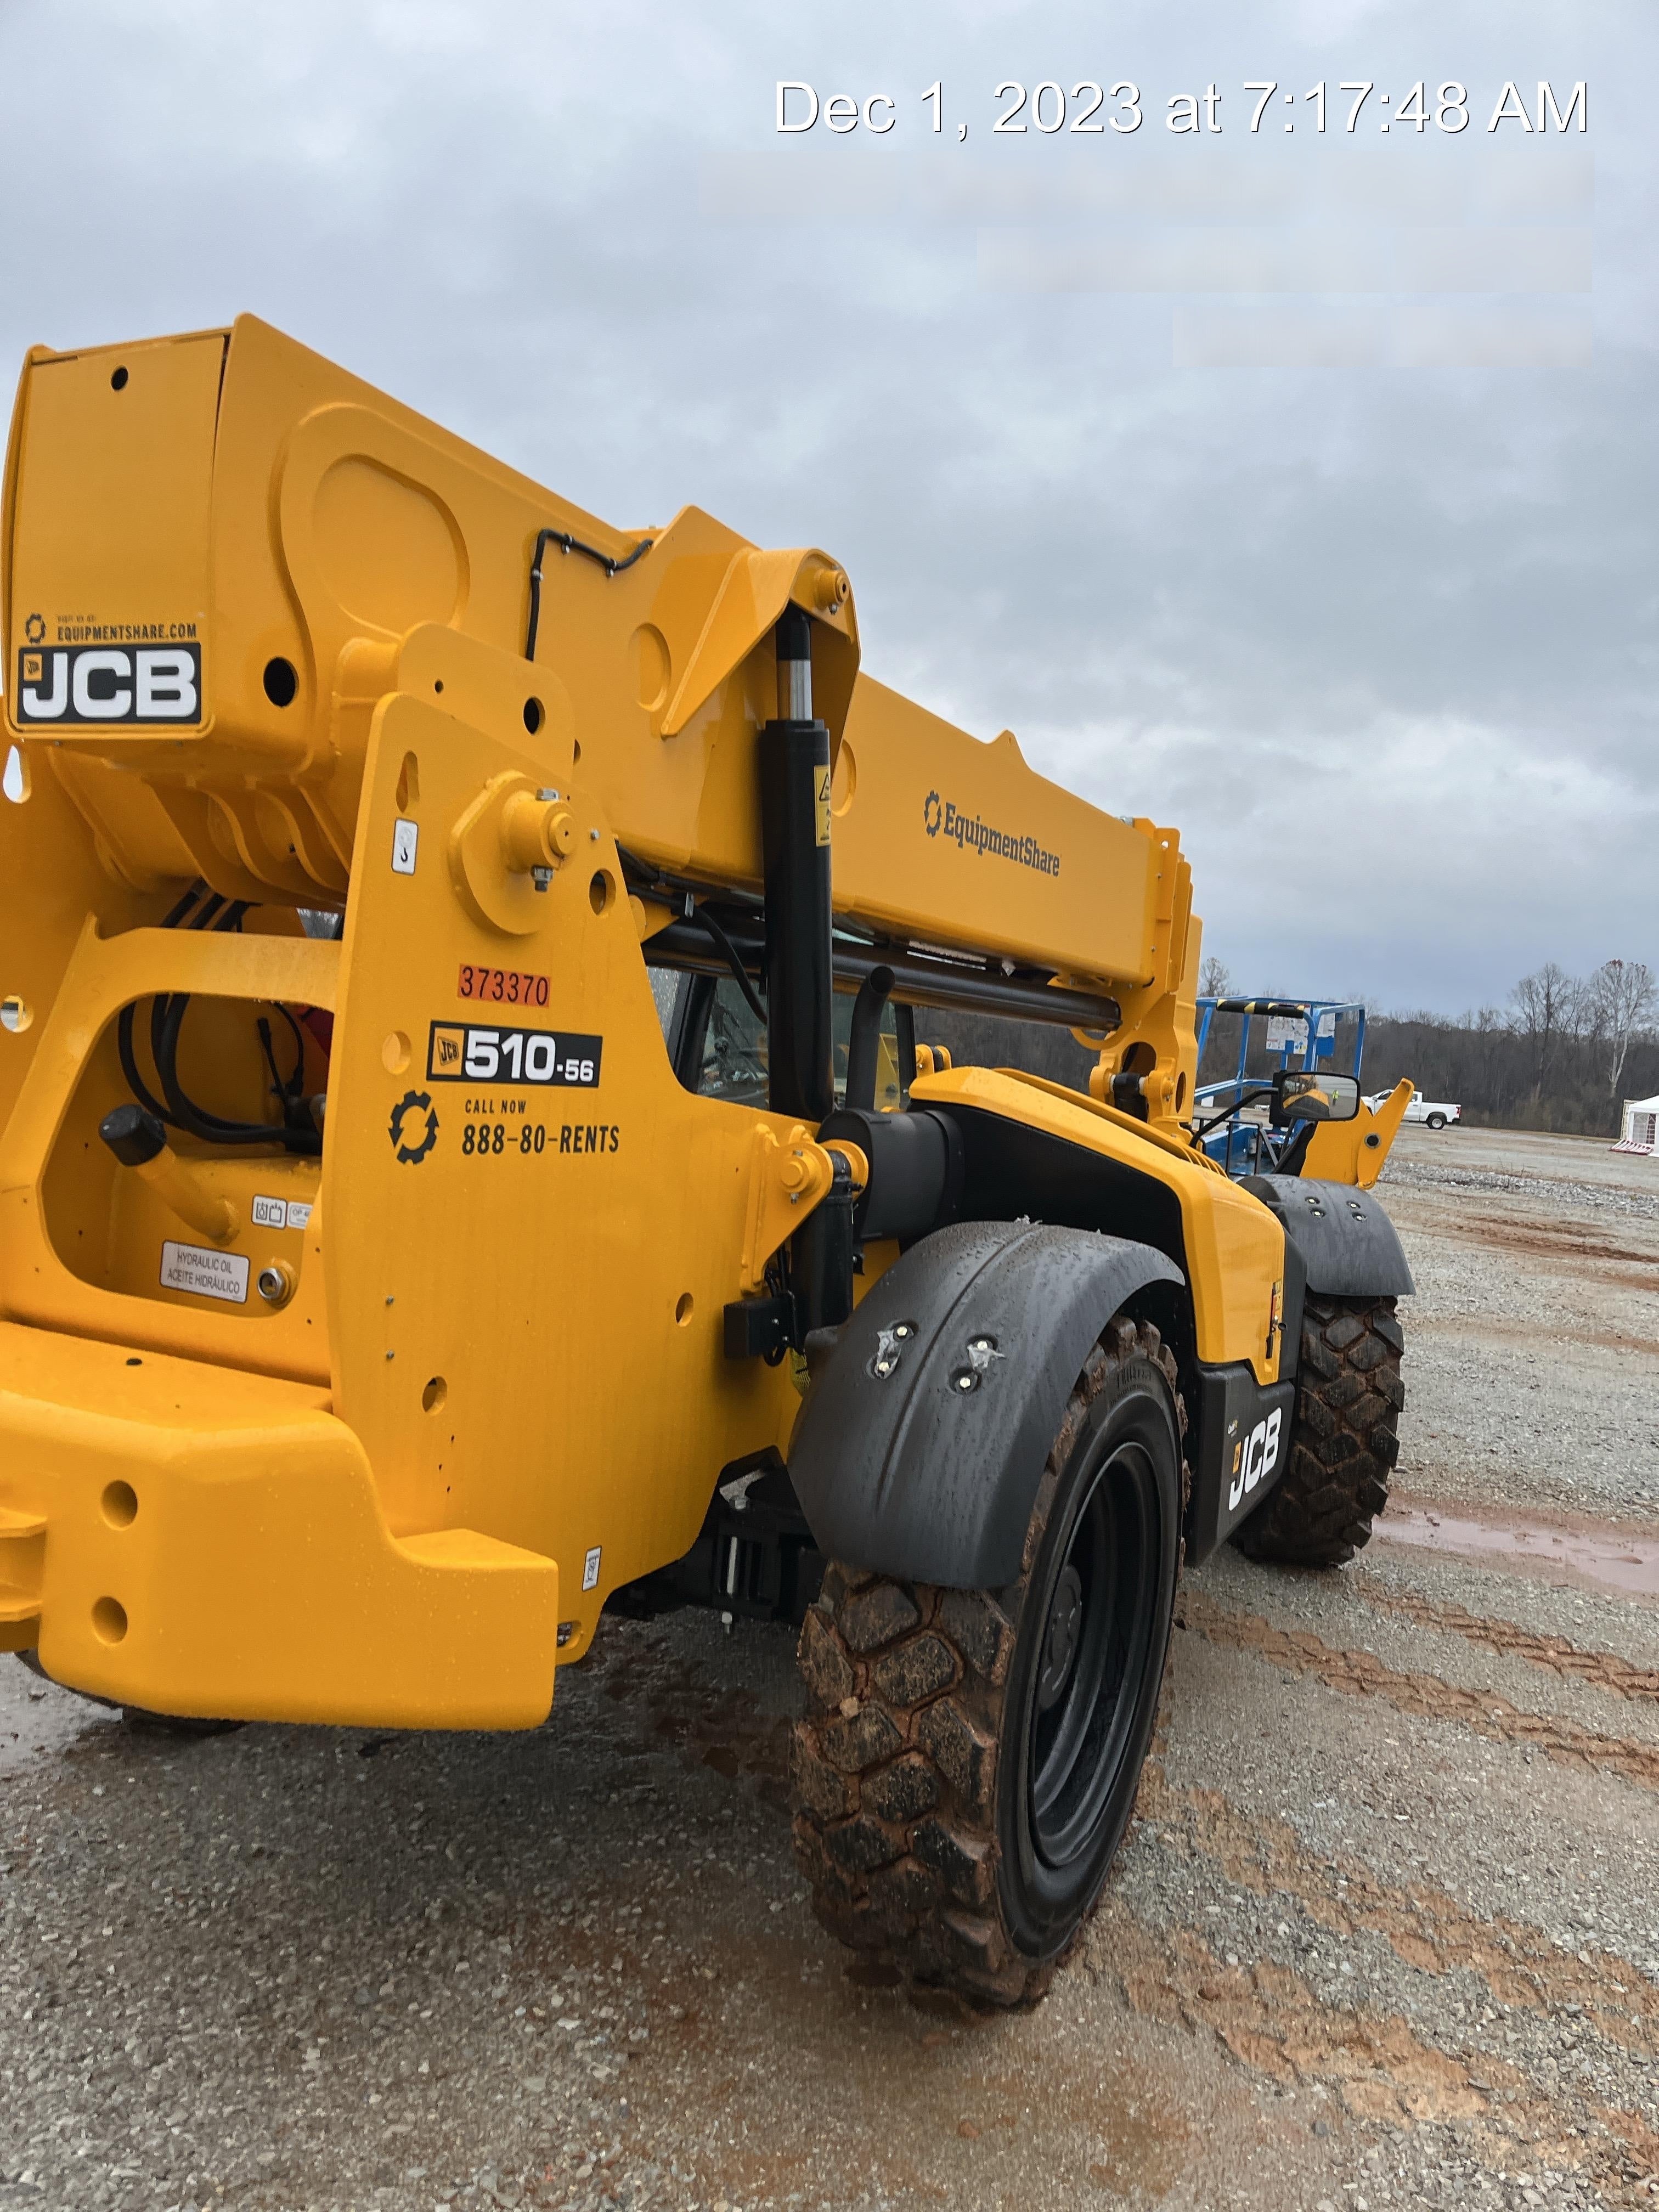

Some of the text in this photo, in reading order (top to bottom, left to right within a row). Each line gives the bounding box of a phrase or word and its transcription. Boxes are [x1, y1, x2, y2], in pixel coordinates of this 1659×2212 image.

[58, 623, 196, 642] EQUIPMENTSHARE.COM
[22, 649, 198, 718] JCB
[944, 802, 1060, 877] EquipmentShare
[460, 965, 549, 1007] 373370
[439, 1040, 459, 1062] JCB
[465, 1099, 527, 1114] CALL NOW
[462, 1124, 620, 1155] 888-80-RENTS
[167, 1268, 193, 1283] ACEITE
[177, 1250, 233, 1274] HYDRAULIC OIL
[1228, 1407, 1282, 1511] JCB
